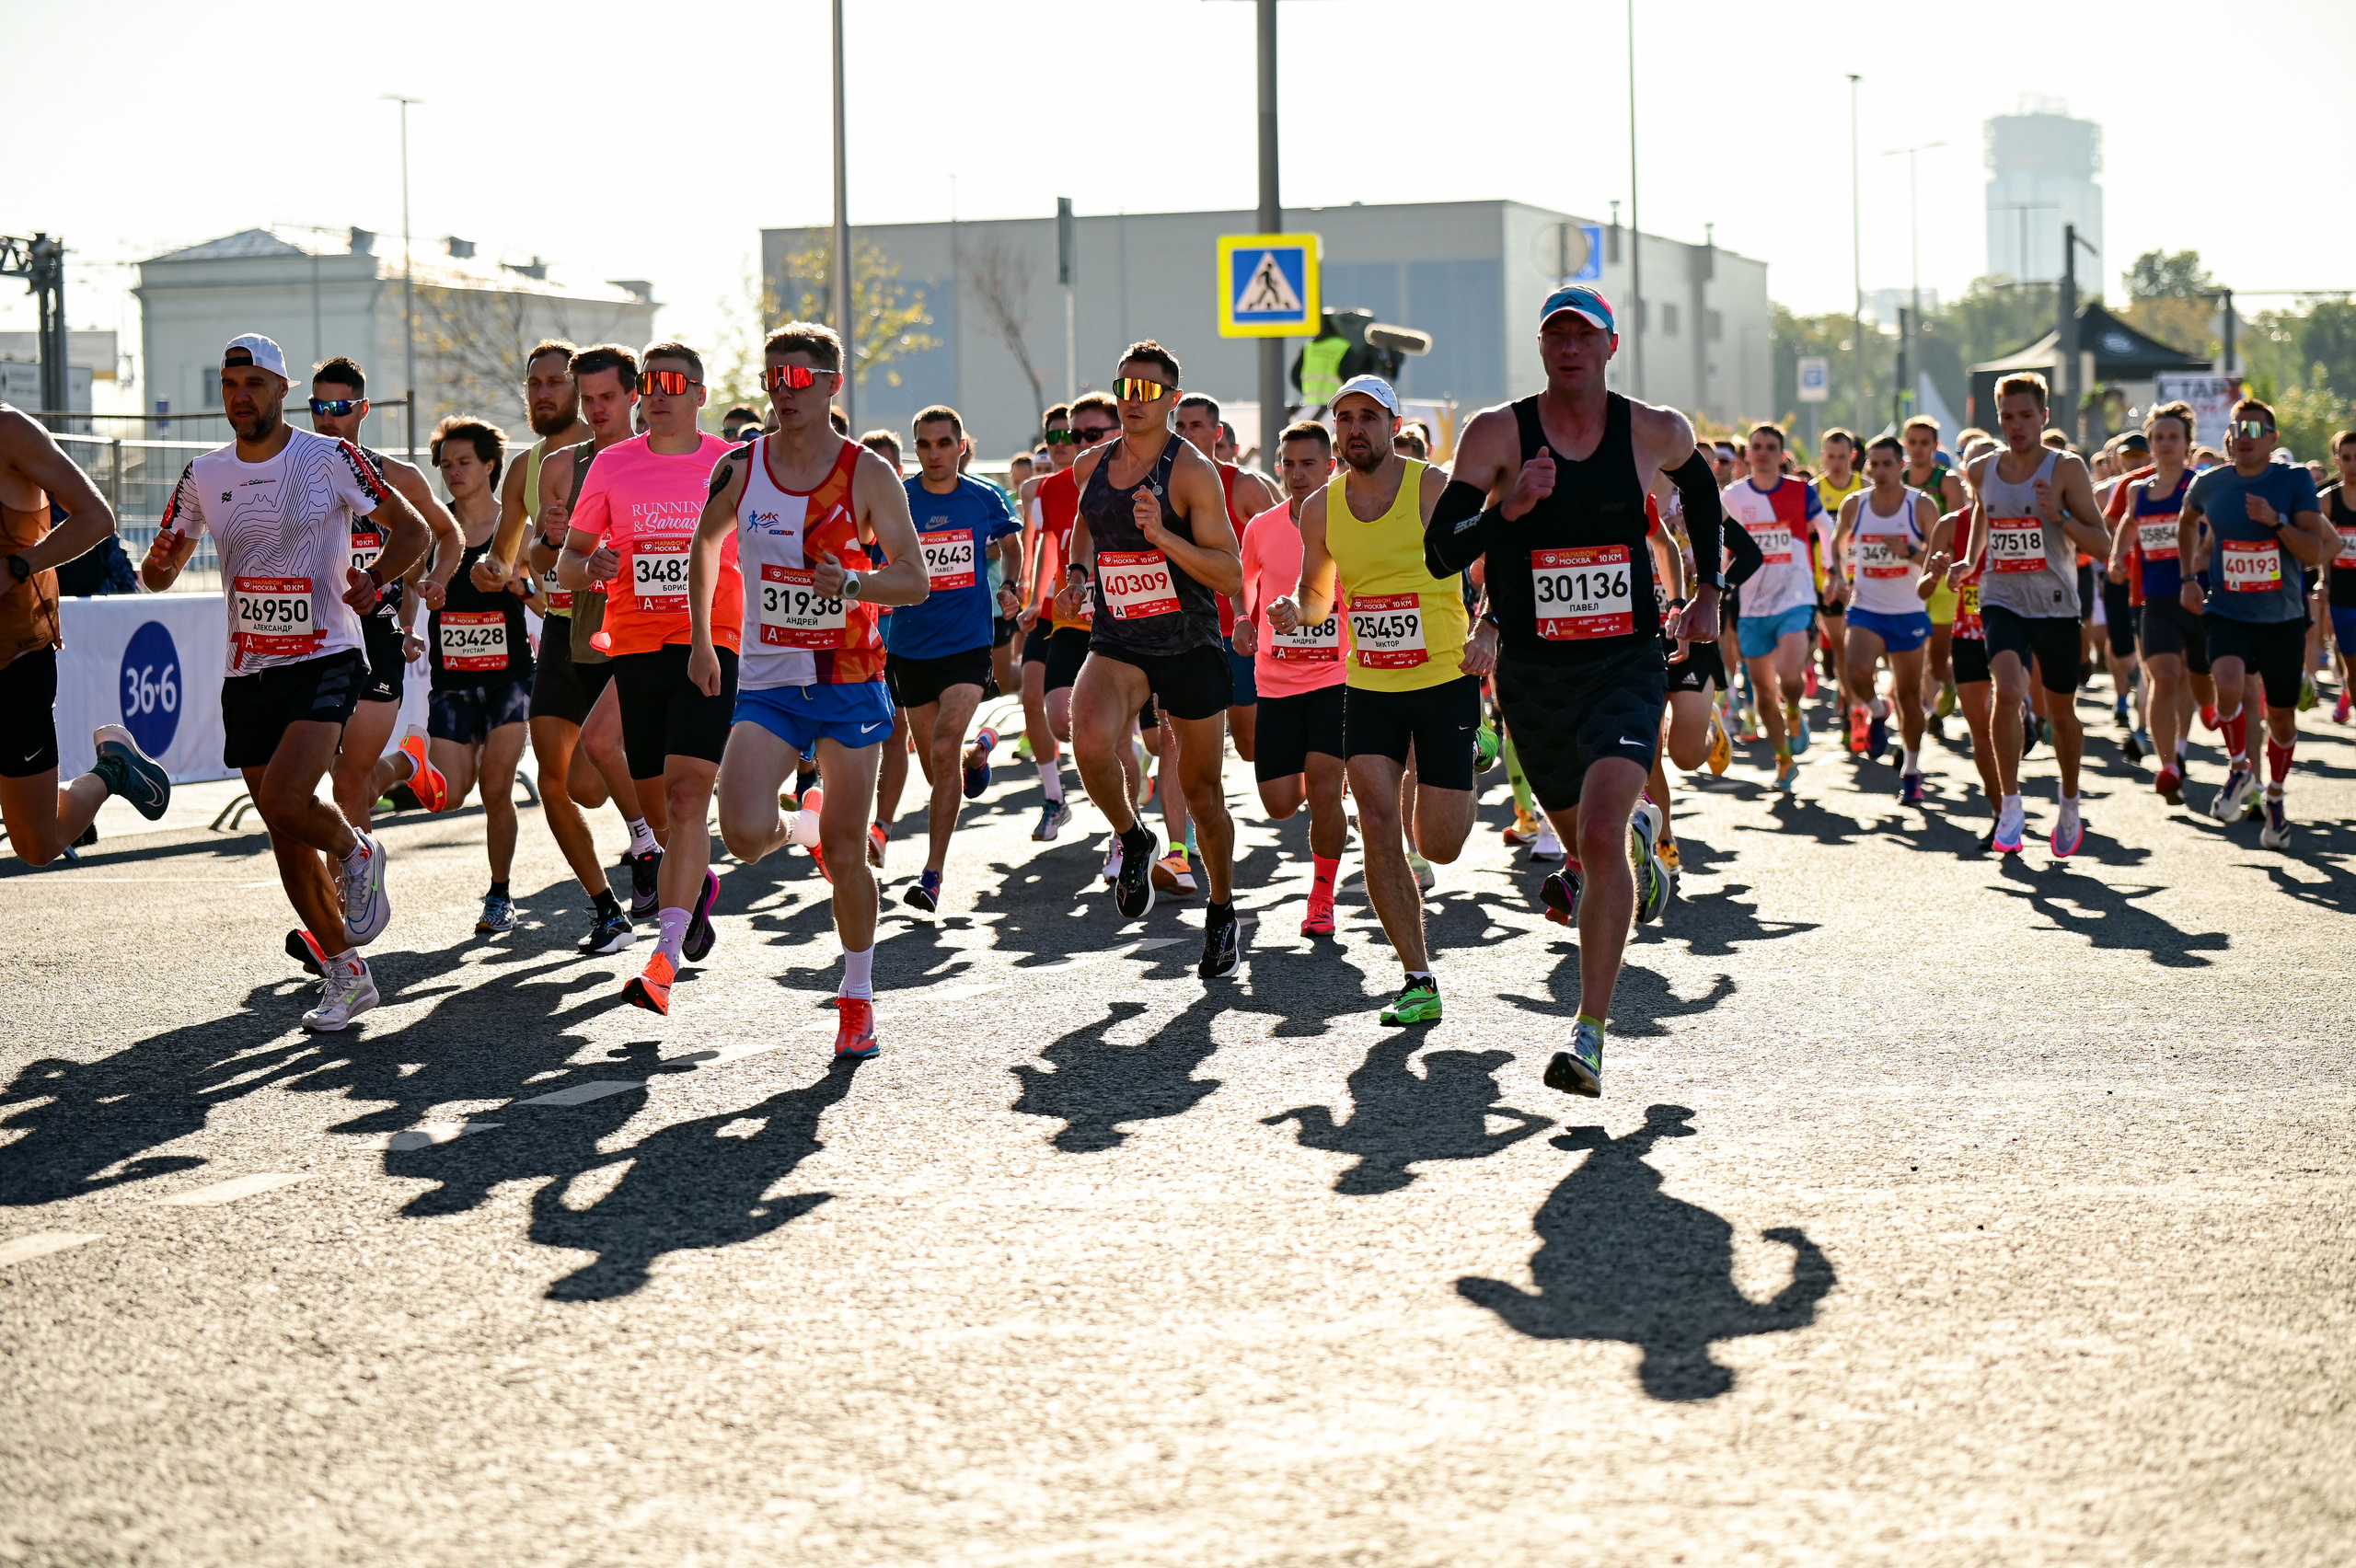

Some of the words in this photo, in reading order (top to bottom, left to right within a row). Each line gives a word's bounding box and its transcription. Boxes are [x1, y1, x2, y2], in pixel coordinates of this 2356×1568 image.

[632, 502, 703, 516] RUNNIN
[633, 521, 644, 533] &
[645, 512, 697, 533] Sarcas
[930, 515, 949, 524] RUN
[1753, 533, 1789, 548] 7210
[1992, 533, 2041, 550] 37518
[925, 545, 972, 567] 9643
[1559, 557, 1591, 565] МОСКВА
[1599, 554, 1608, 562] 10
[2225, 557, 2279, 574] 40193
[783, 575, 812, 583] МОСКВА
[1105, 571, 1168, 595] 40309
[1537, 571, 1628, 603] 30136
[239, 597, 308, 622] 26950
[763, 587, 843, 616] 31938
[1569, 603, 1600, 613] ПАВЕЛ
[253, 623, 293, 632] АЛЕКСАНДР
[786, 617, 818, 626] АНДРЕЙ
[1353, 614, 1418, 639] 25459
[444, 628, 504, 647] 23428
[1374, 640, 1400, 648] ВИКТОР
